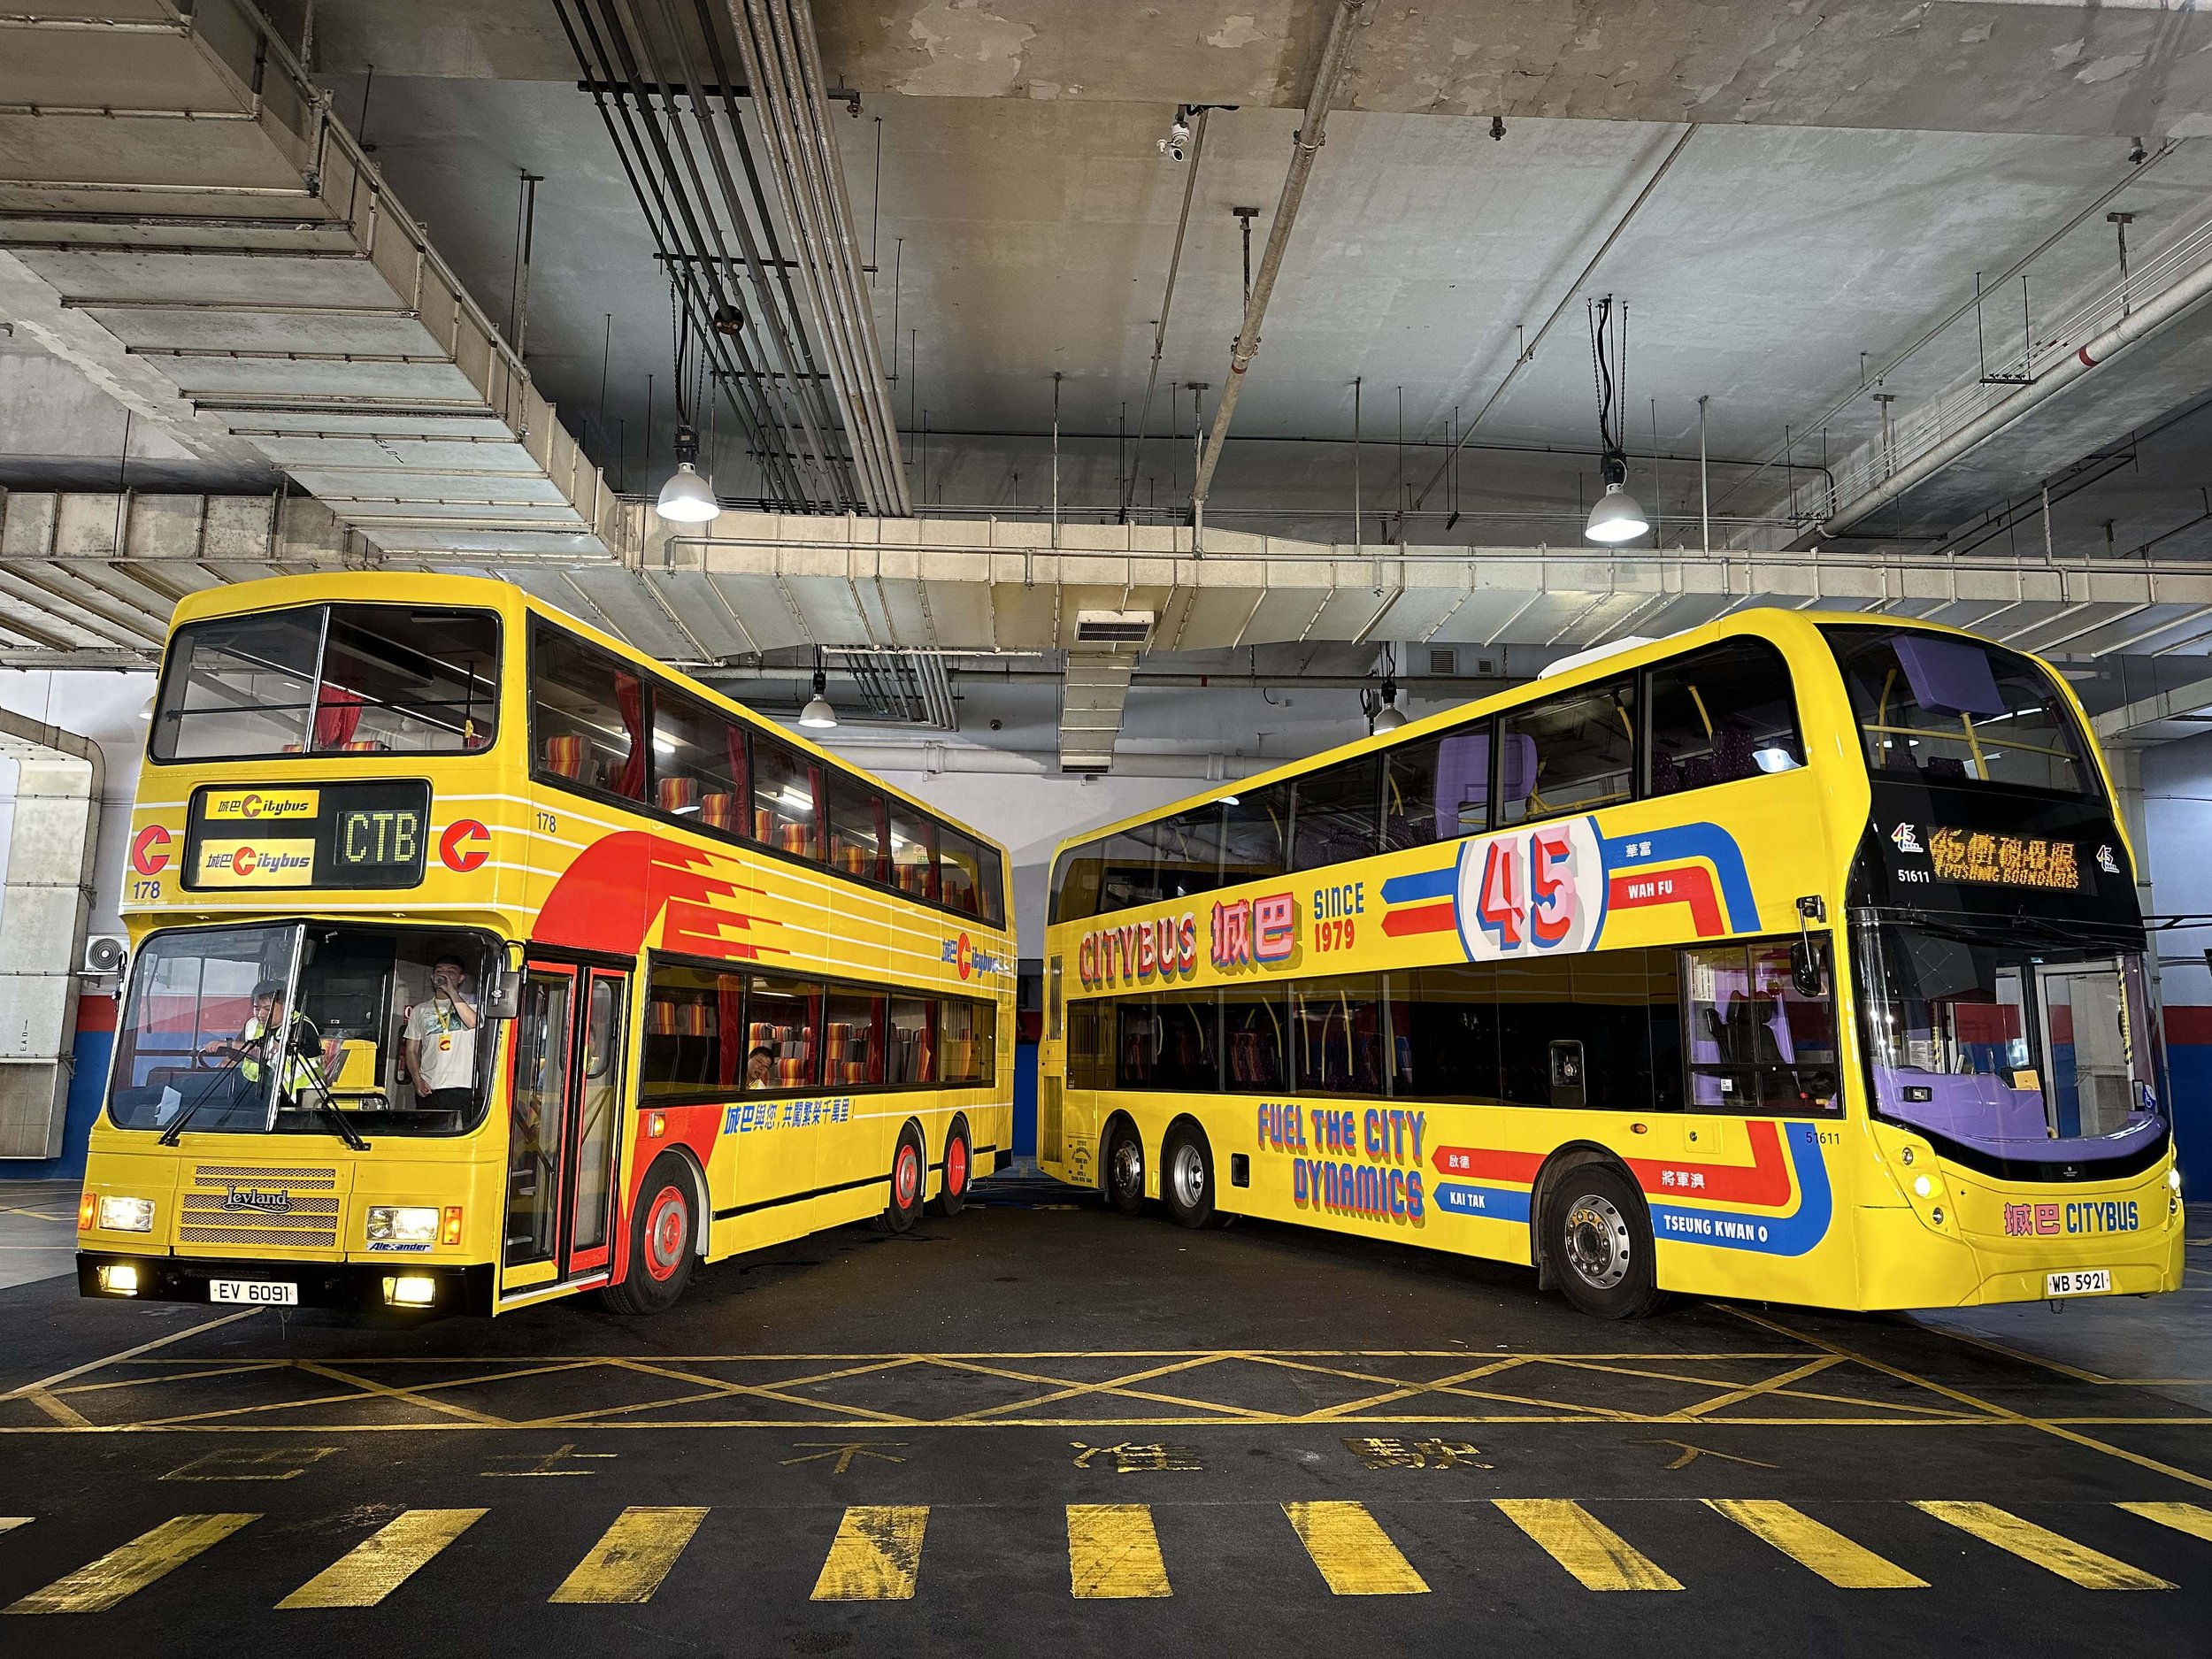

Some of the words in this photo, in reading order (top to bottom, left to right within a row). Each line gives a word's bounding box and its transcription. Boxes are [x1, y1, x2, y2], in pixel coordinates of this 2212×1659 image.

[218, 800, 242, 813] 城巴
[242, 795, 309, 818] Citybus
[536, 811, 557, 833] 178
[345, 812, 418, 863] CTB
[1625, 841, 1652, 858] 華富
[205, 854, 234, 869] 城巴
[233, 847, 311, 876] Citybus
[1898, 869, 1930, 883] 51611
[133, 881, 161, 900] 178
[1476, 825, 1578, 951] 45
[1628, 881, 1653, 900] WAH
[1656, 879, 1673, 897] FU
[1314, 882, 1364, 919] SINCE
[1079, 911, 1197, 990] CITYBUS
[1211, 892, 1301, 974] 城巴
[1315, 918, 1356, 953] 1979
[941, 938, 957, 964] 城巴
[1257, 1103, 1308, 1155] FUEL
[1311, 1109, 1356, 1156] THE
[1364, 1109, 1427, 1167] CITY
[1805, 1131, 1840, 1145] 51611
[1661, 1171, 1706, 1190] 將軍澳
[227, 1186, 289, 1205] Leyland
[1294, 1157, 1426, 1229] DYNAMICS
[1450, 1191, 1465, 1206] KAI
[1468, 1194, 1486, 1209] TAK
[1663, 1214, 1712, 1237] TSEUNG
[1715, 1218, 1755, 1240] KWAN
[1757, 1225, 1769, 1242] O
[2004, 1202, 2060, 1236] 城巴
[2065, 1201, 2139, 1233] CITYBUS
[369, 1242, 431, 1252] Alexander
[219, 1284, 242, 1302] EV
[250, 1284, 290, 1302] 6091
[2053, 1275, 2070, 1293] WB
[2074, 1272, 2107, 1292] 5921
